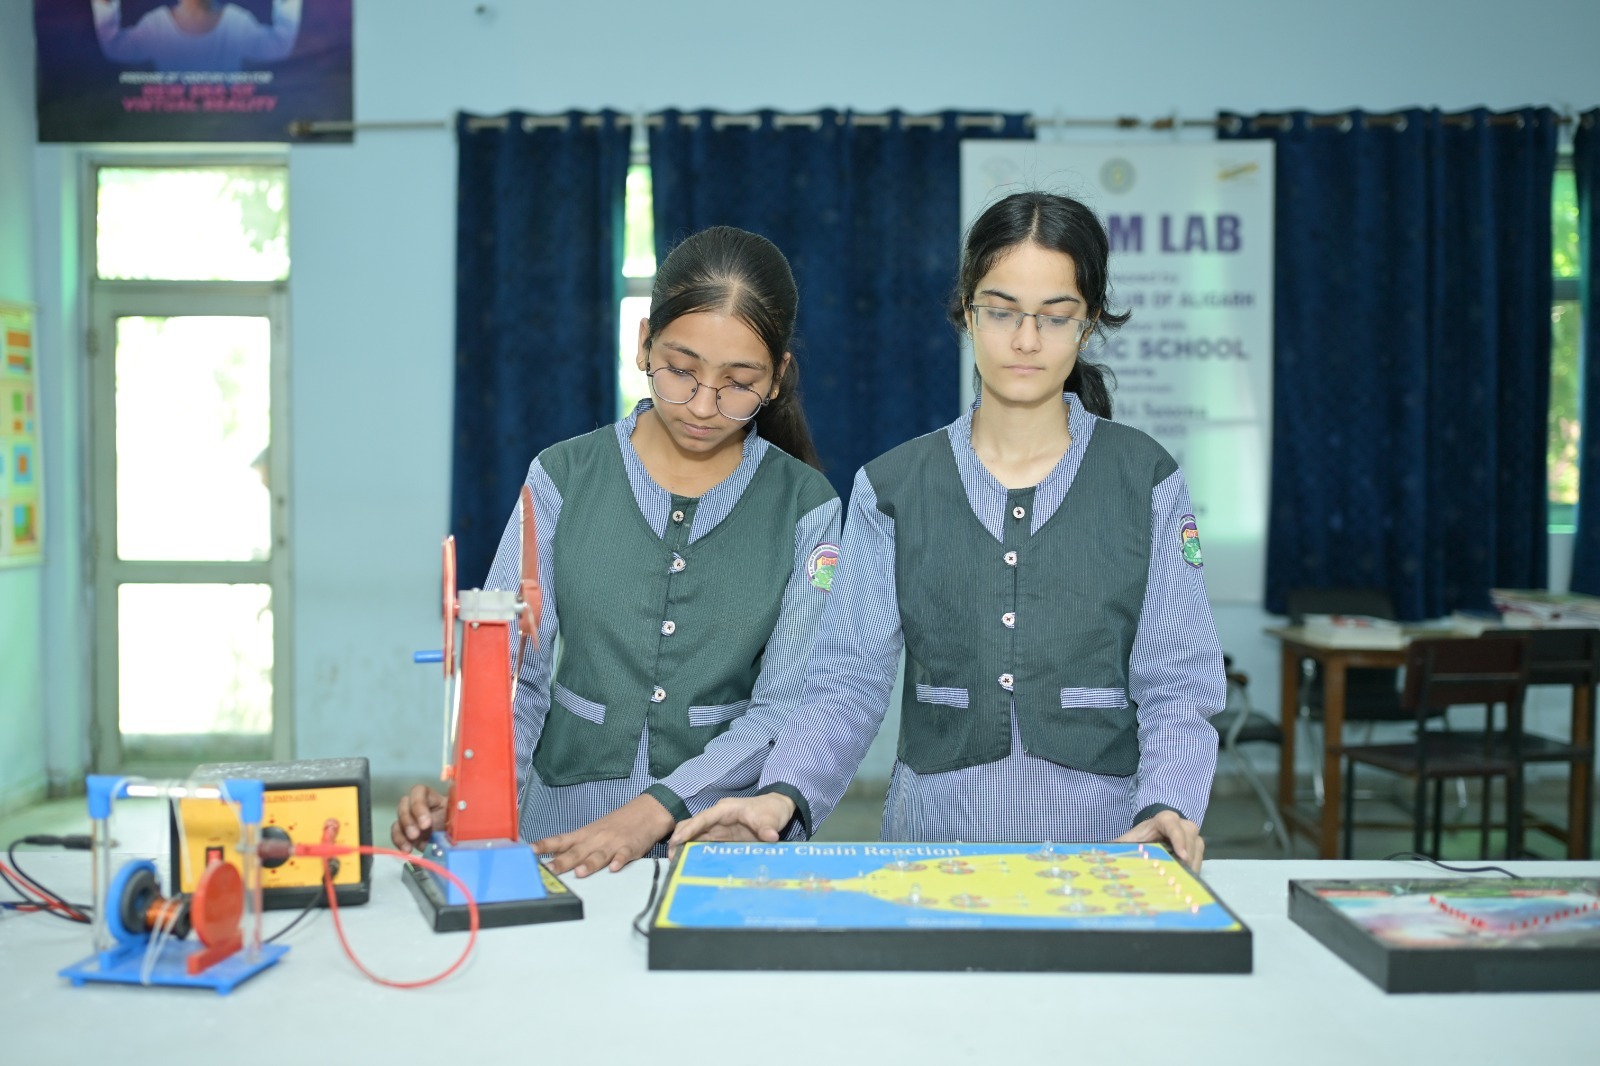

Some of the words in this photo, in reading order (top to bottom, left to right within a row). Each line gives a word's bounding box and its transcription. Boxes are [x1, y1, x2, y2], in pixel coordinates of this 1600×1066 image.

[121, 97, 197, 112] VIRTUAL
[203, 96, 277, 111] REALITY
[1160, 213, 1243, 254] LAB
[1138, 338, 1249, 360] SCHOOL
[702, 845, 788, 856] Nuclear
[794, 845, 857, 856] Chain
[864, 846, 961, 857] Reaction
